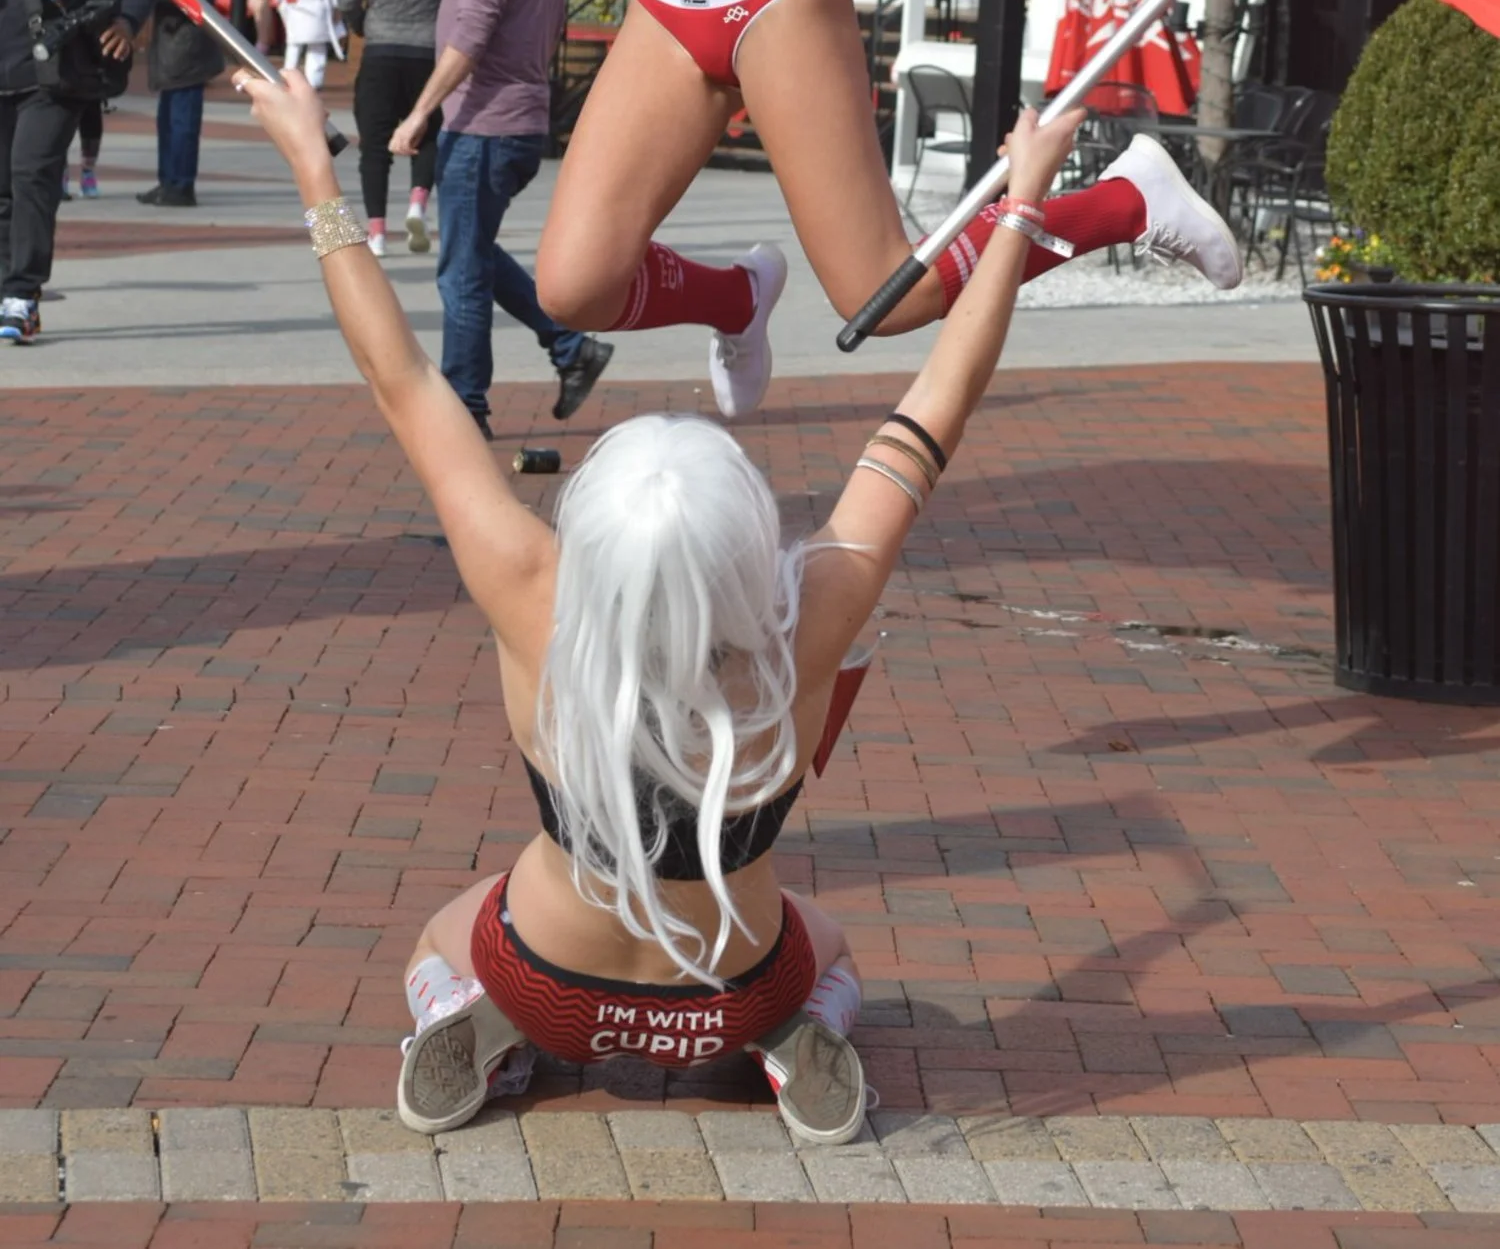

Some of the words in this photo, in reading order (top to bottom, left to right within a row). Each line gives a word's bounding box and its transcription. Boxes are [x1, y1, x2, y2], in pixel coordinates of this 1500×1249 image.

[597, 1004, 637, 1025] I'M
[647, 1009, 724, 1031] WITH
[590, 1030, 724, 1059] CUPID
